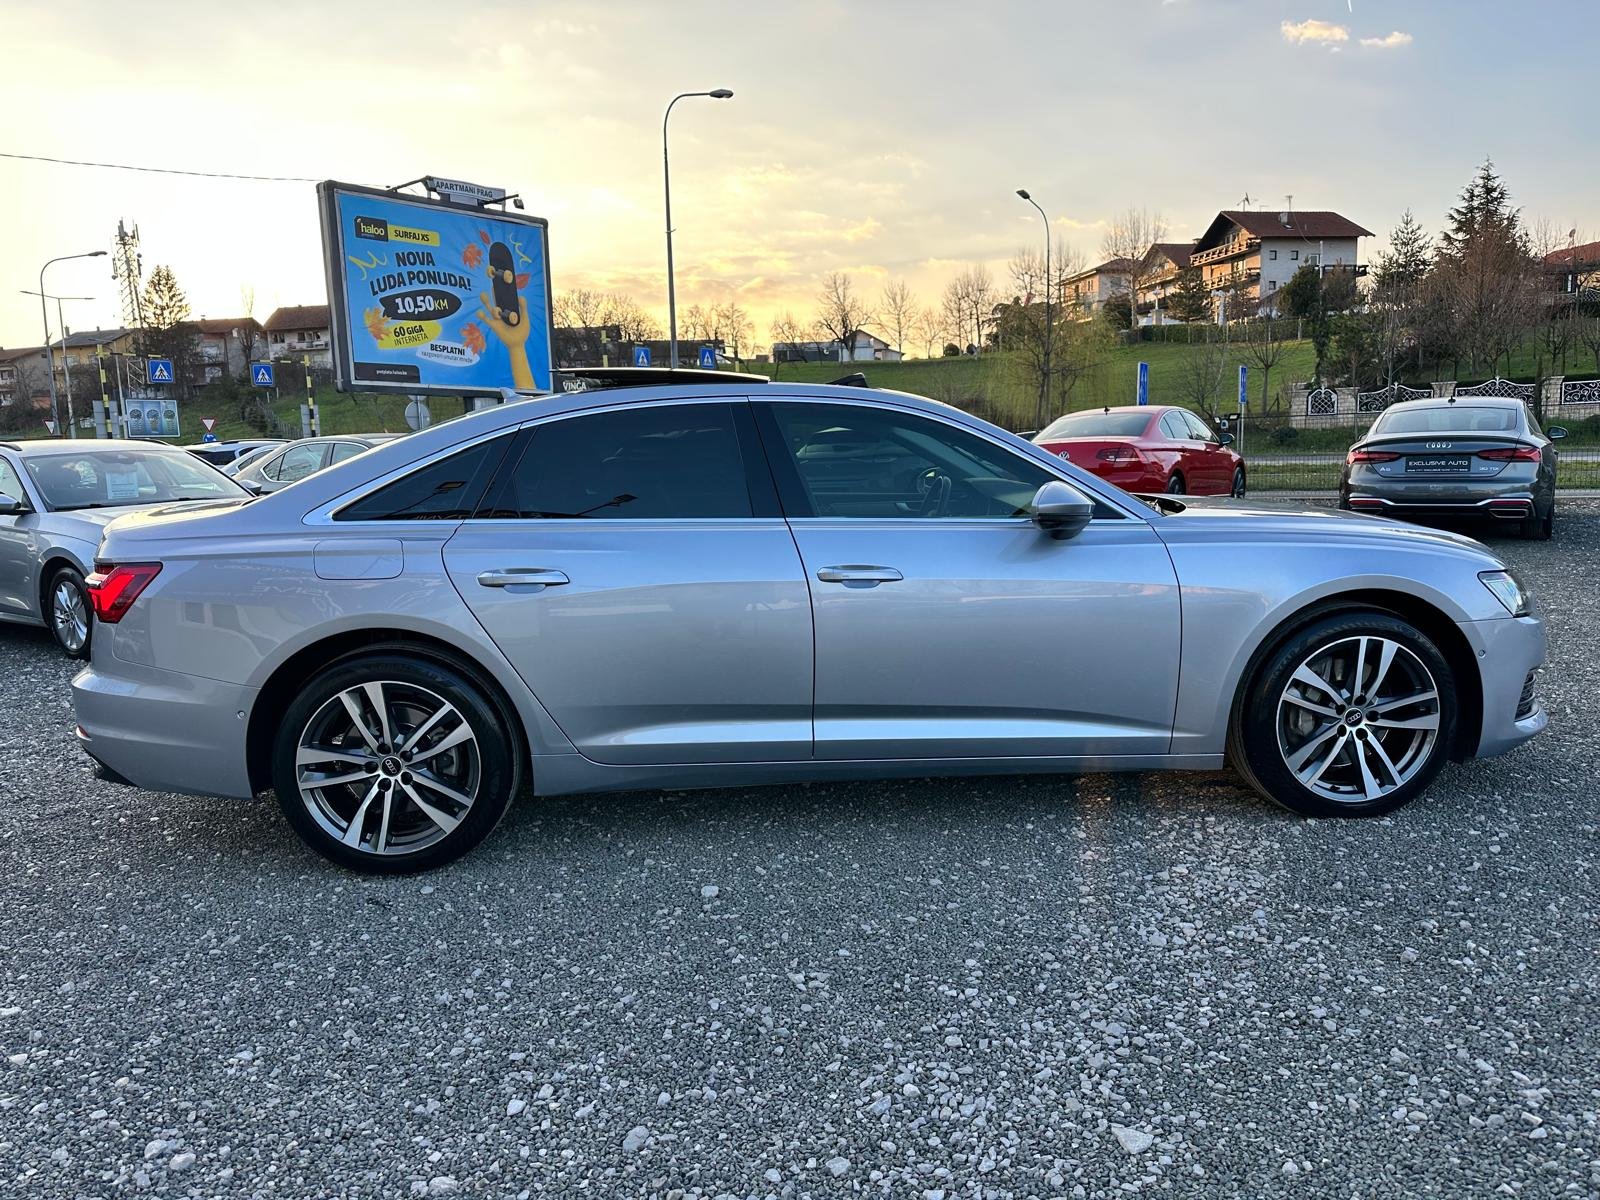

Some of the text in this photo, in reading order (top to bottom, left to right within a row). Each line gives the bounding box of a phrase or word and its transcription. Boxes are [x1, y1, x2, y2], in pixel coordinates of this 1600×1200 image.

[436, 181, 492, 198] APARTMANI PRAG
[360, 222, 384, 236] haloo
[394, 230, 420, 240] SURFAJ
[395, 252, 435, 267] NOVA
[370, 270, 472, 296] LUDA PONUDA!
[394, 325, 424, 338] 60 GIGA
[394, 333, 428, 346] INTERNETA
[430, 344, 465, 356] BESPLATNI
[562, 379, 586, 390] VINČA
